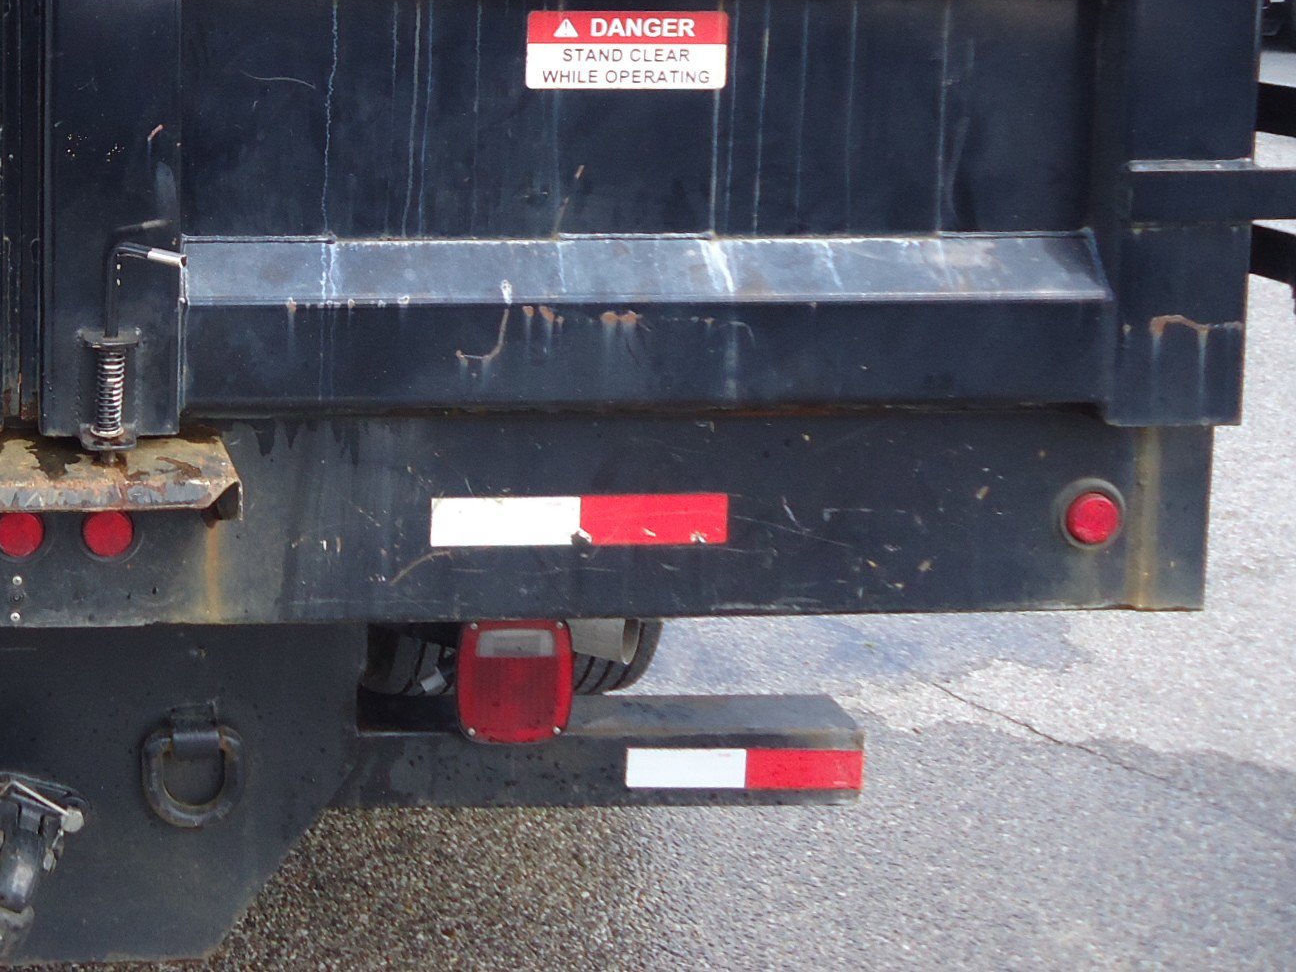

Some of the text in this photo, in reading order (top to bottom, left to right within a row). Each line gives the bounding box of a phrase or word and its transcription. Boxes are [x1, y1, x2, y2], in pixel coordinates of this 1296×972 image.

[590, 18, 696, 37] DANGER
[562, 48, 690, 62] STAND CLEAR
[542, 70, 710, 84] WHILE OPERATING
